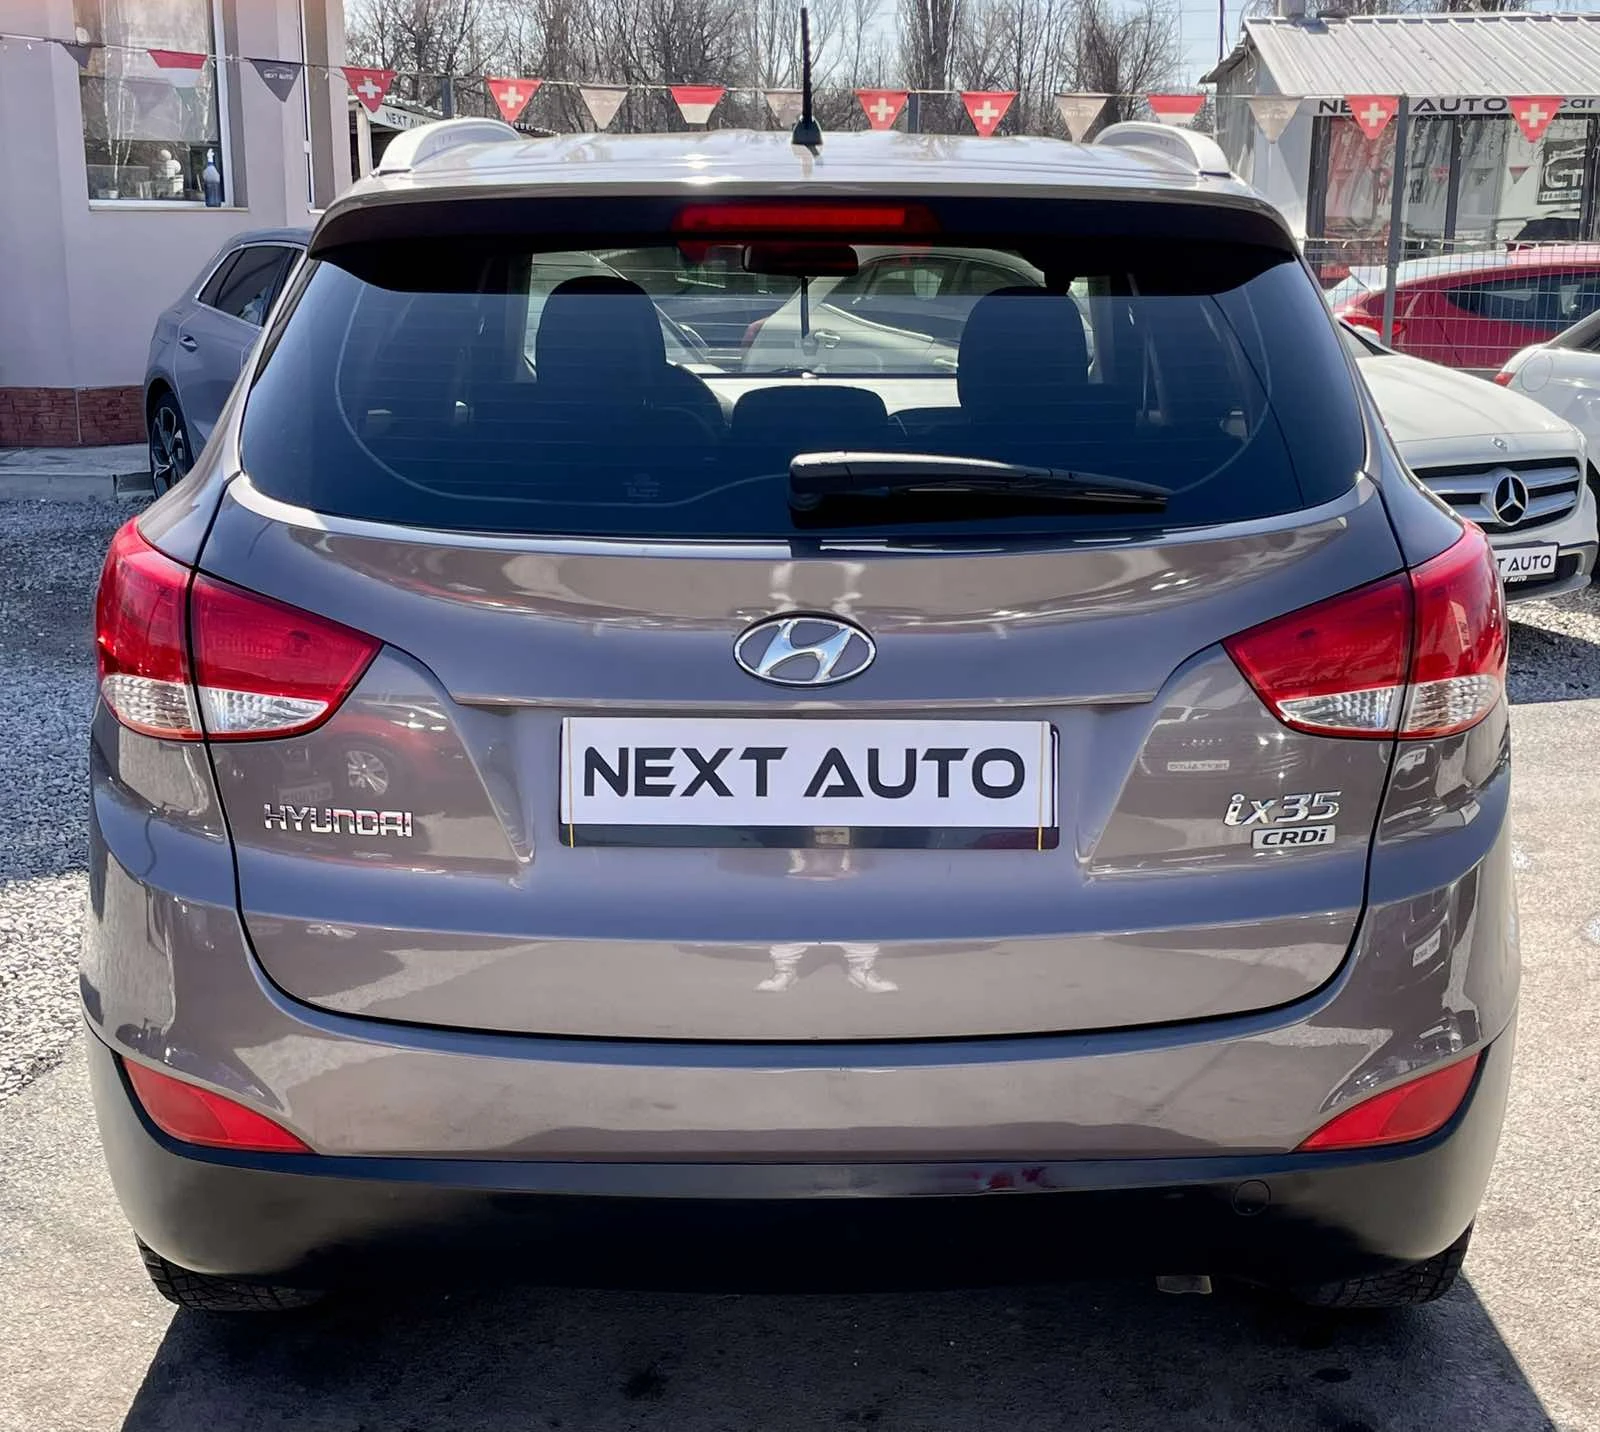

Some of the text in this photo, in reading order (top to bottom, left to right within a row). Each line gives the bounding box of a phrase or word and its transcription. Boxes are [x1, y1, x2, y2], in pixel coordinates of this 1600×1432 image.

[1319, 99, 1353, 114] NE
[1413, 98, 1507, 112] AUTO
[385, 111, 407, 128] NEXT
[1508, 554, 1552, 572] AUTO
[584, 747, 1026, 799] NEXT AUTO
[1223, 791, 1342, 827] ix35
[263, 803, 413, 838] HYUNDAI
[1261, 828, 1328, 846] CRDi
